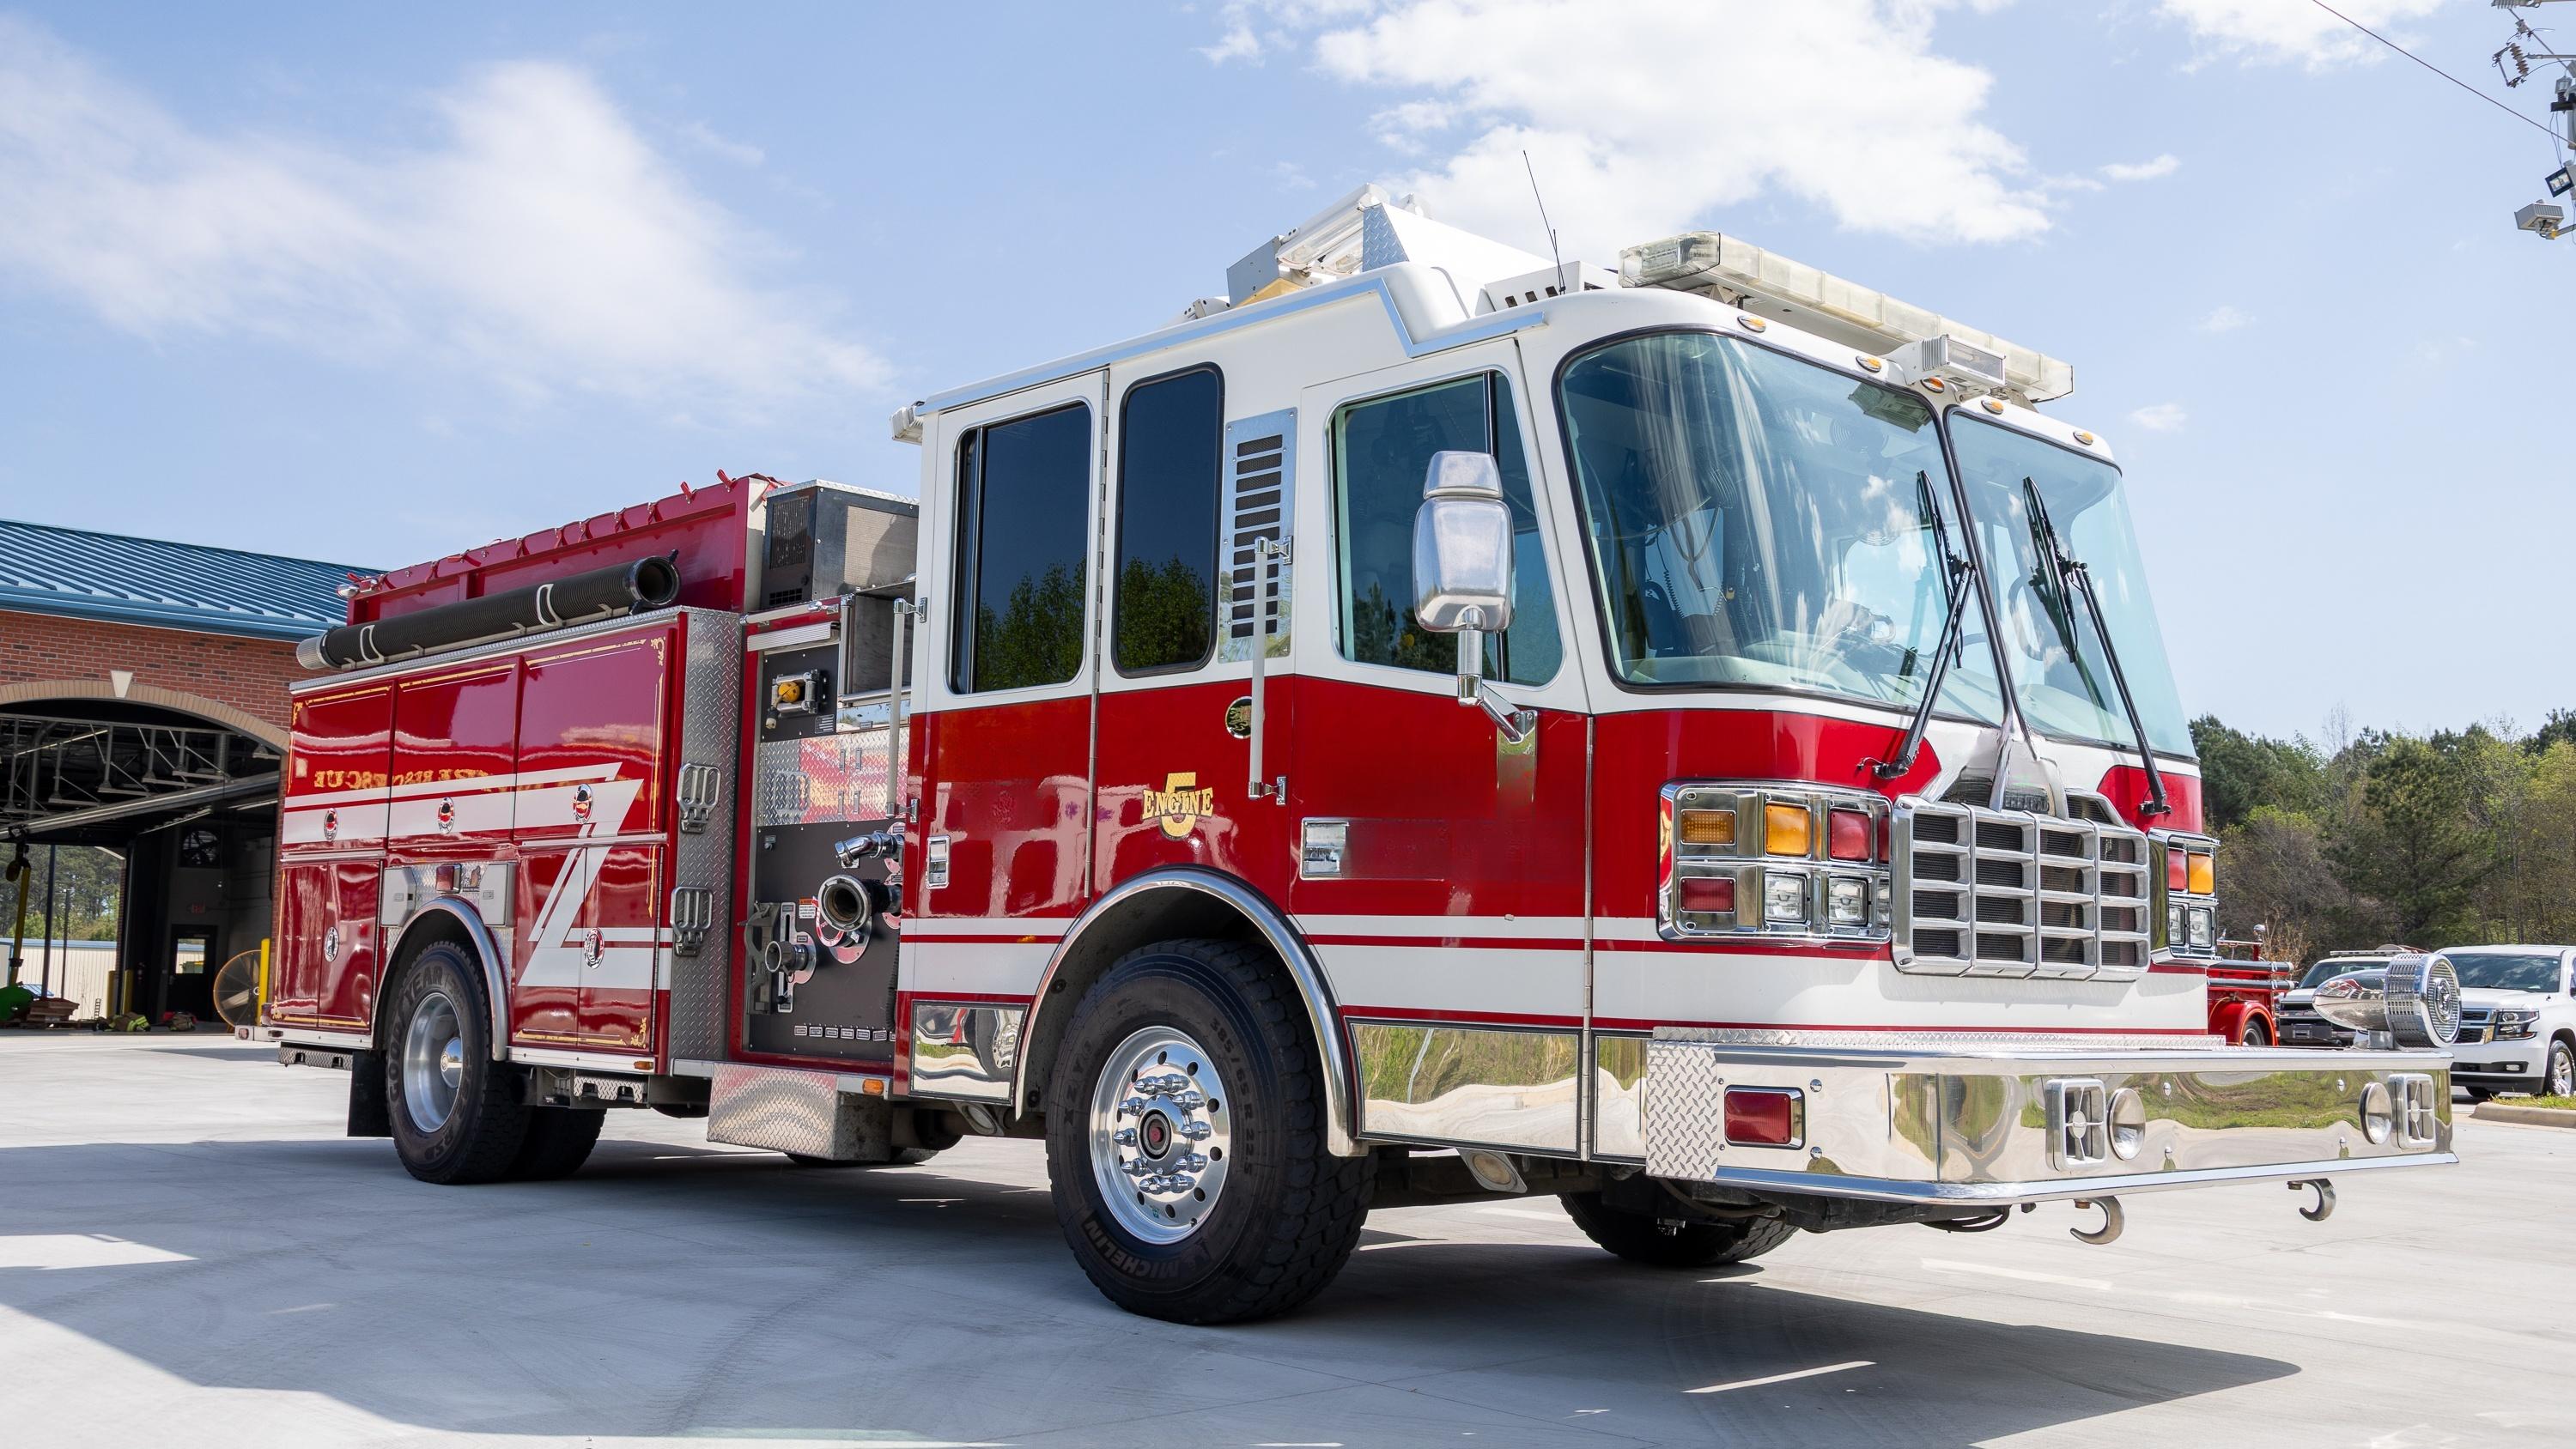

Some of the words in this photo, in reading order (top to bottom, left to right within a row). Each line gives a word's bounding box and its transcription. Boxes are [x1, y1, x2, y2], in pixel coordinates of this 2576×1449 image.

[1142, 786, 1213, 820] ENGINE
[1162, 772, 1196, 837] 5
[388, 965, 443, 1102] GOODYEAR
[1084, 1220, 1180, 1279] MICHELIN
